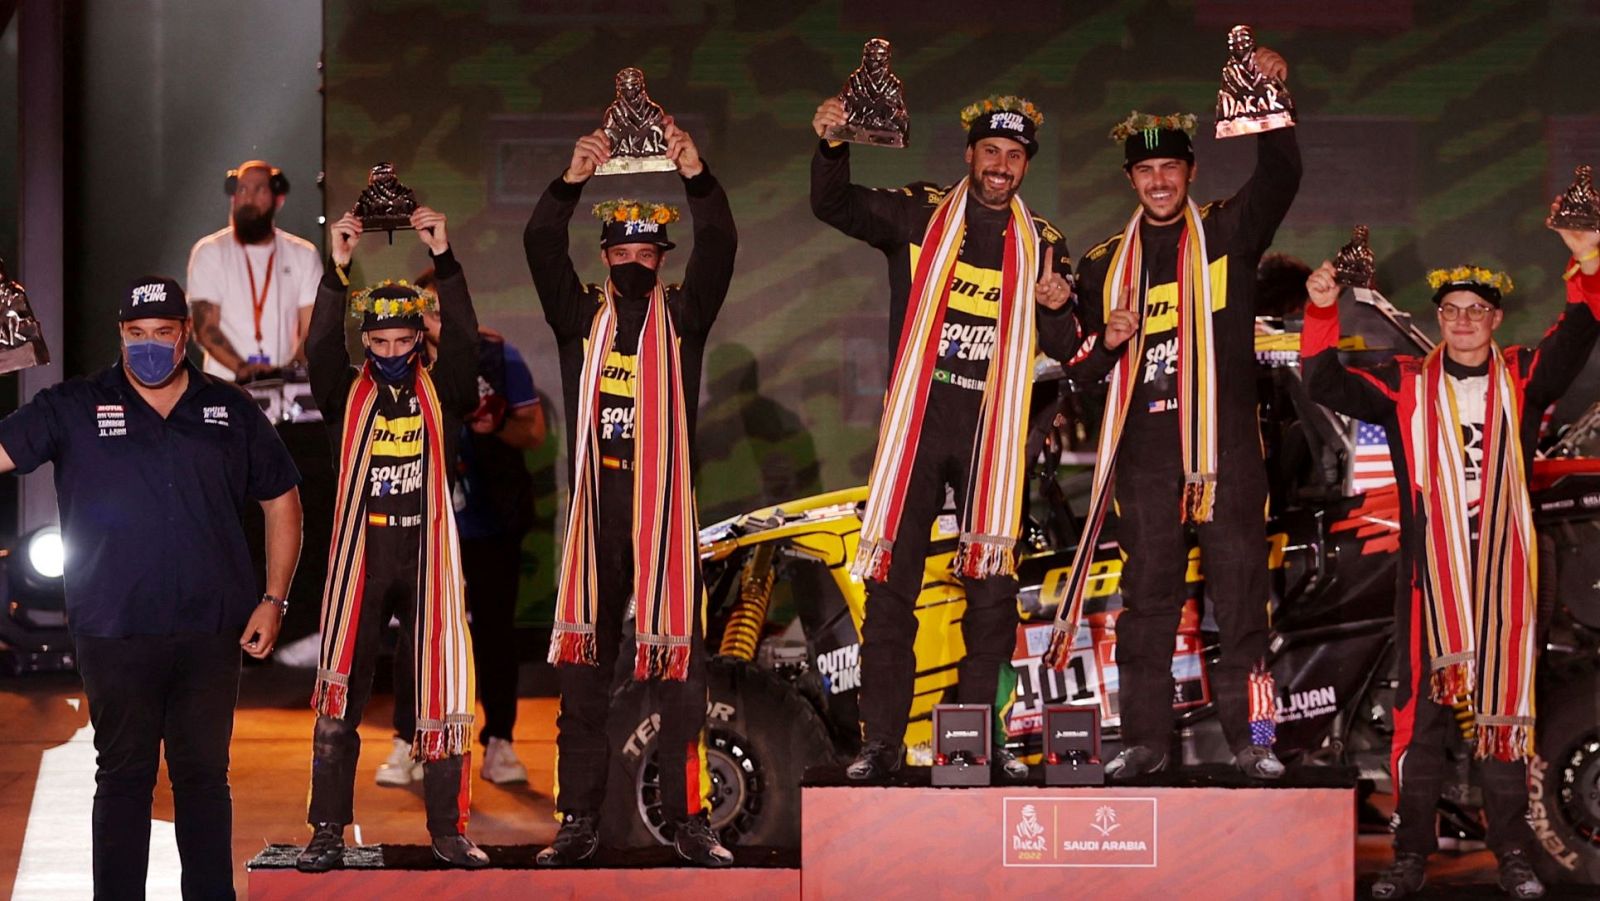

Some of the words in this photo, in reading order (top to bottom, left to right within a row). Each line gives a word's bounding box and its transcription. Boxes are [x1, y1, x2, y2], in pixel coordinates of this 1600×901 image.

[1219, 83, 1285, 118] DAKAR
[991, 112, 1024, 123] SOUTH
[132, 283, 165, 296] SOUTH
[817, 643, 859, 675] OUTH
[1012, 835, 1047, 851] DAKAR
[1063, 840, 1100, 851] SAUDI
[1101, 840, 1147, 851] ARABIA
[1018, 851, 1042, 860] 2022
